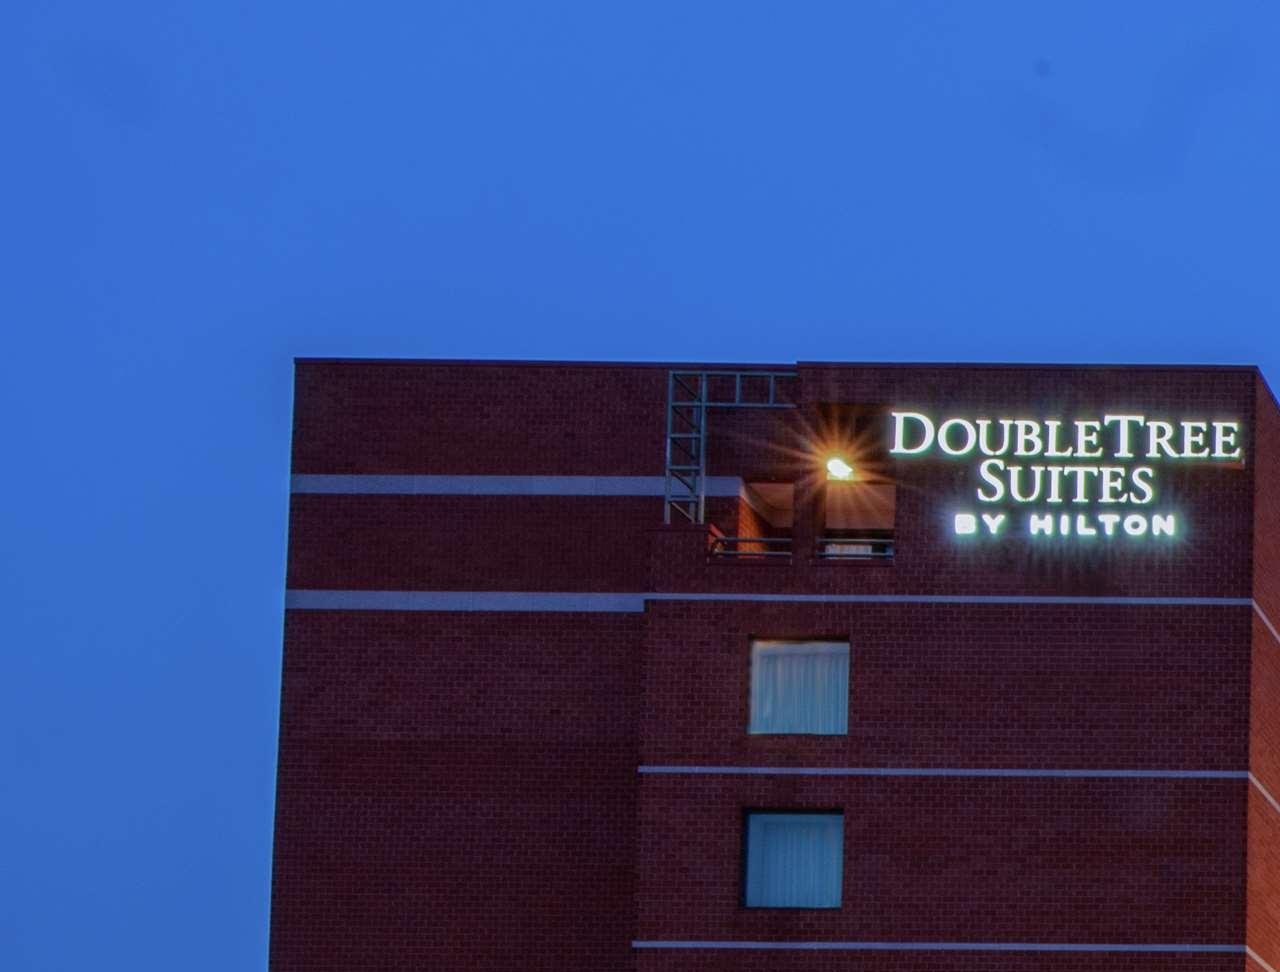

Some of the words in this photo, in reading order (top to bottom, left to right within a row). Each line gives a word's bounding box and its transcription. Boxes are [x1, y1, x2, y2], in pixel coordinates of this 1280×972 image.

[977, 458, 1154, 504] SUITES
[954, 513, 1005, 535] BY
[1030, 513, 1176, 536] HILTON
